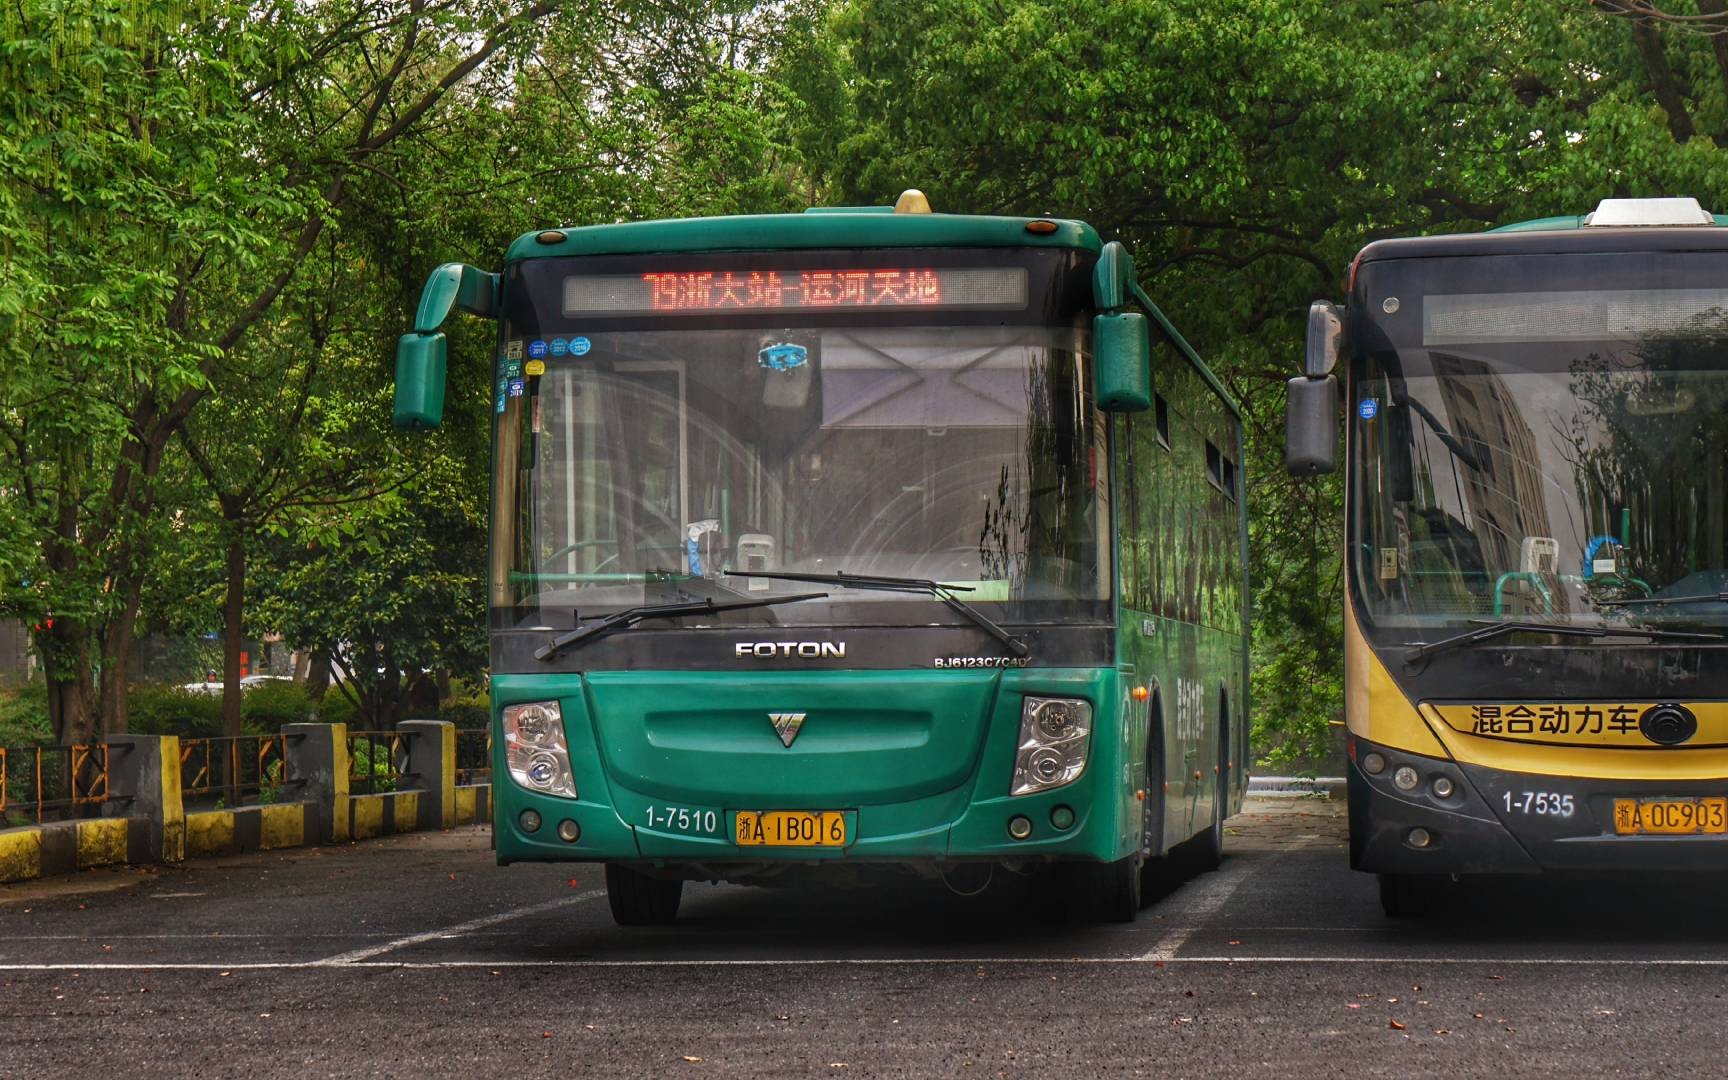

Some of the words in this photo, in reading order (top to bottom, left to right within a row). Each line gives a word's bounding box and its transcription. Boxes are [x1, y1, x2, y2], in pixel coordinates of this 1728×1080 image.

[735, 642, 846, 658] FOTON
[1471, 705, 1639, 735] 混合动力车
[1503, 791, 1575, 817] 1-7535
[646, 805, 716, 833] 1-7510
